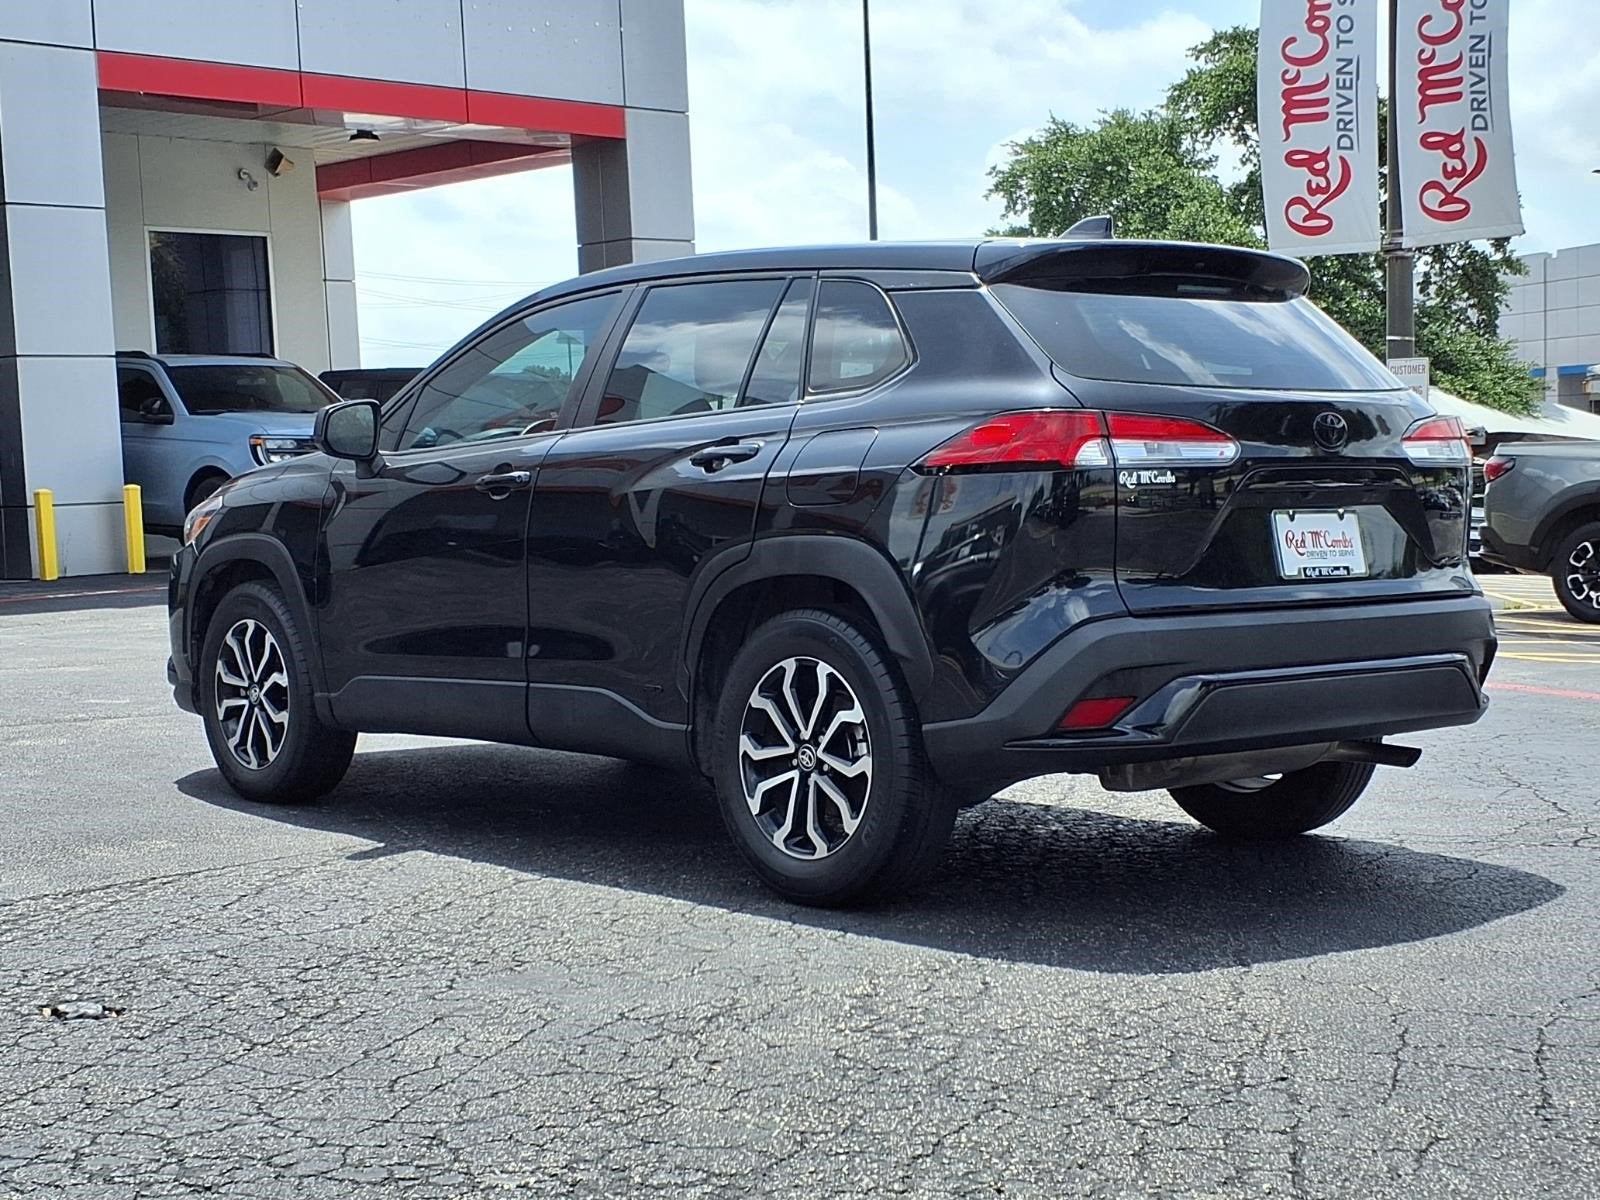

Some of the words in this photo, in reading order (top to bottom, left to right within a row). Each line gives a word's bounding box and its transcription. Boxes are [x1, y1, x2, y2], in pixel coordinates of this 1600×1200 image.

[1336, 14, 1354, 50] TO
[1469, 34, 1488, 131] DRIVEN
[1336, 58, 1354, 151] DRIVEN
[1284, 145, 1352, 236] Red
[1419, 126, 1488, 222] Red
[1390, 364, 1426, 375] CUSTOMER
[1119, 471, 1138, 489] Red
[1138, 470, 1176, 484] McCombs
[1285, 530, 1307, 556] Red
[1307, 530, 1354, 549] McCombs
[1306, 550, 1328, 558] DRIVEN
[1337, 549, 1355, 557] SERVE
